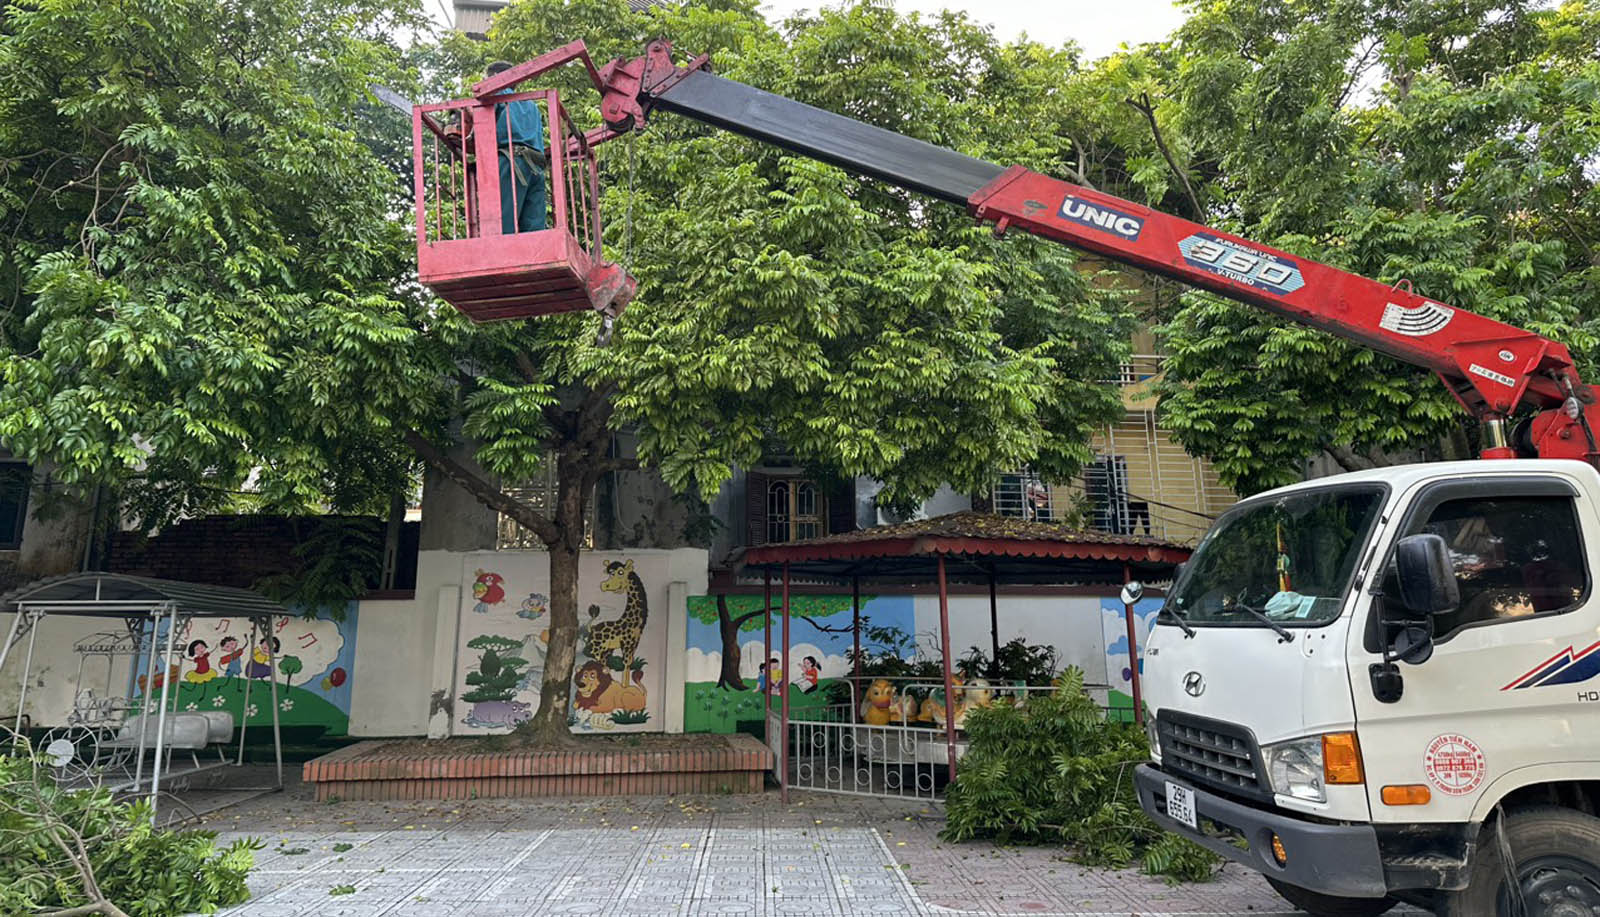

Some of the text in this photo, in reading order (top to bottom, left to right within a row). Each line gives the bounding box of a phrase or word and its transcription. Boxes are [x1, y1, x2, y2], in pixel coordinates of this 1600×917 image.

[1062, 199, 1140, 236] UNIC
[1190, 240, 1293, 286] 360
[1216, 267, 1255, 286] V-TURBO
